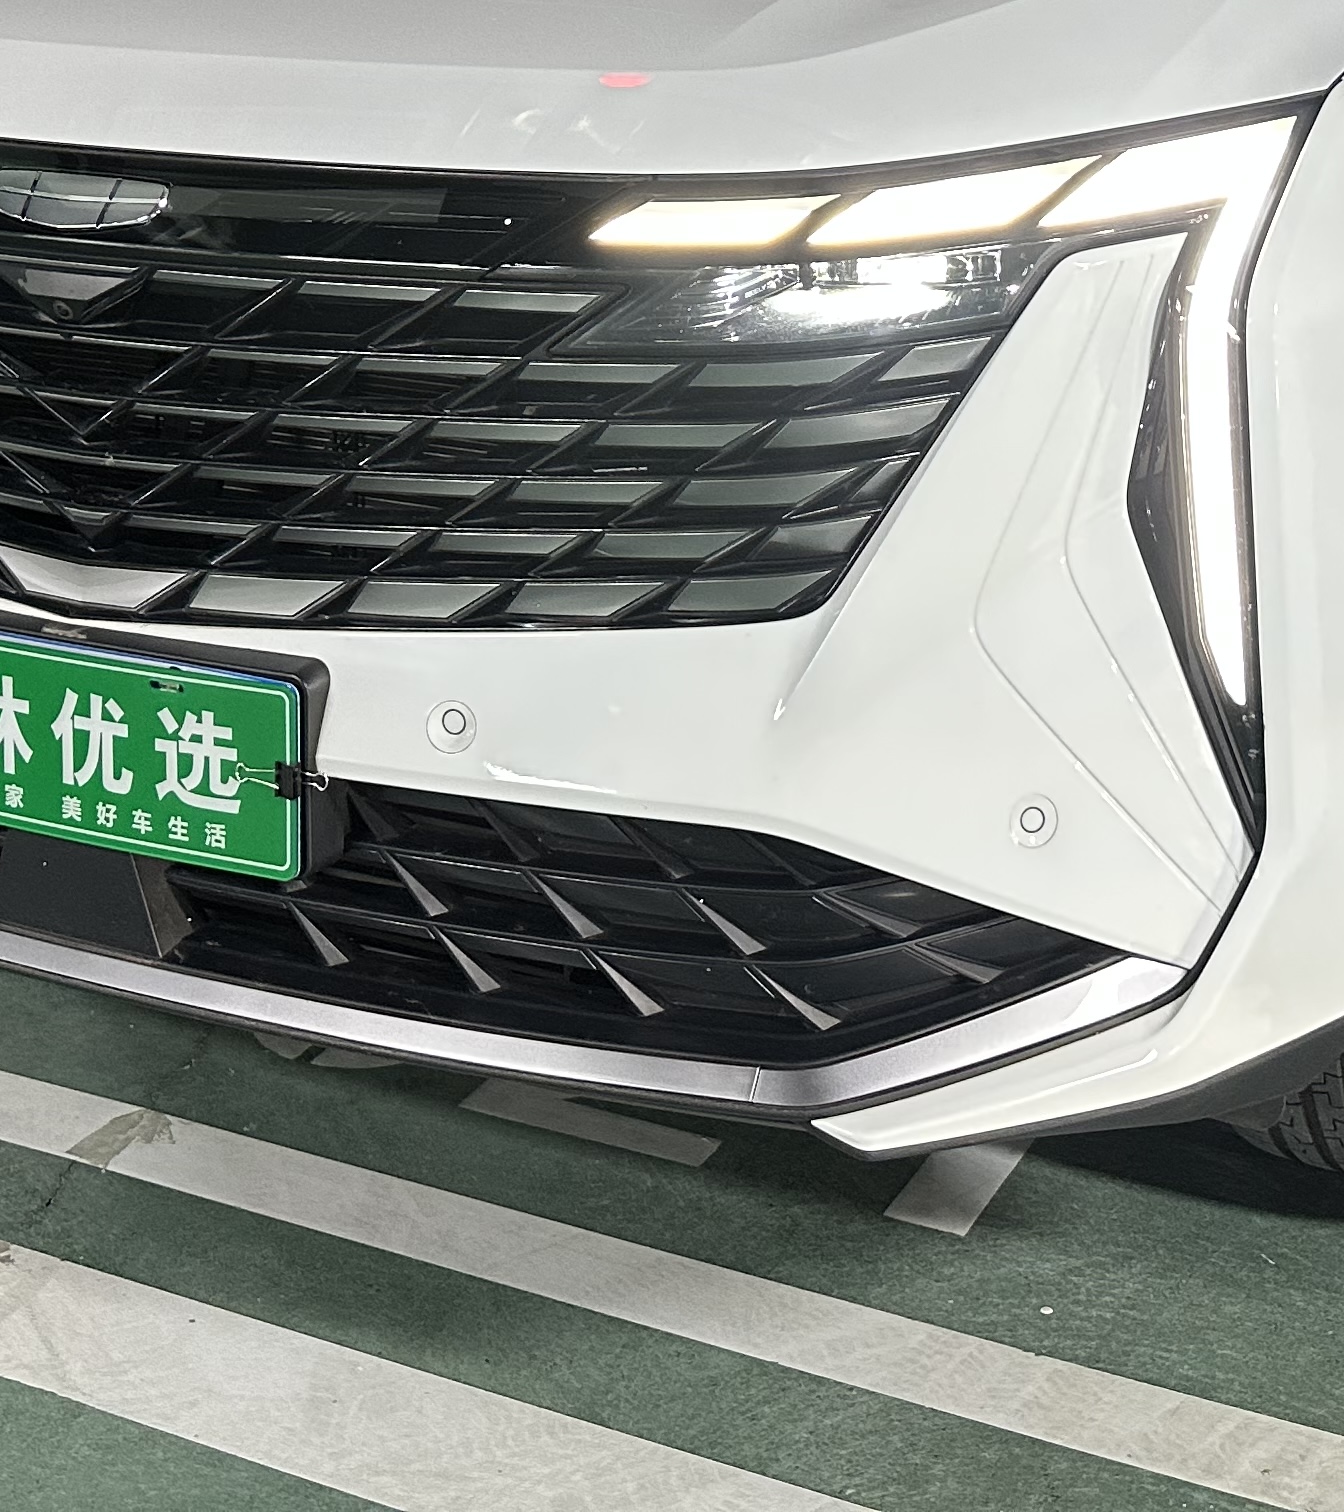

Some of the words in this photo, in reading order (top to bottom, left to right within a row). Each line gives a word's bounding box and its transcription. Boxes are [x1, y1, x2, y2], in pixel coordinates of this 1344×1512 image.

[62, 795, 227, 849] 美好车生活
